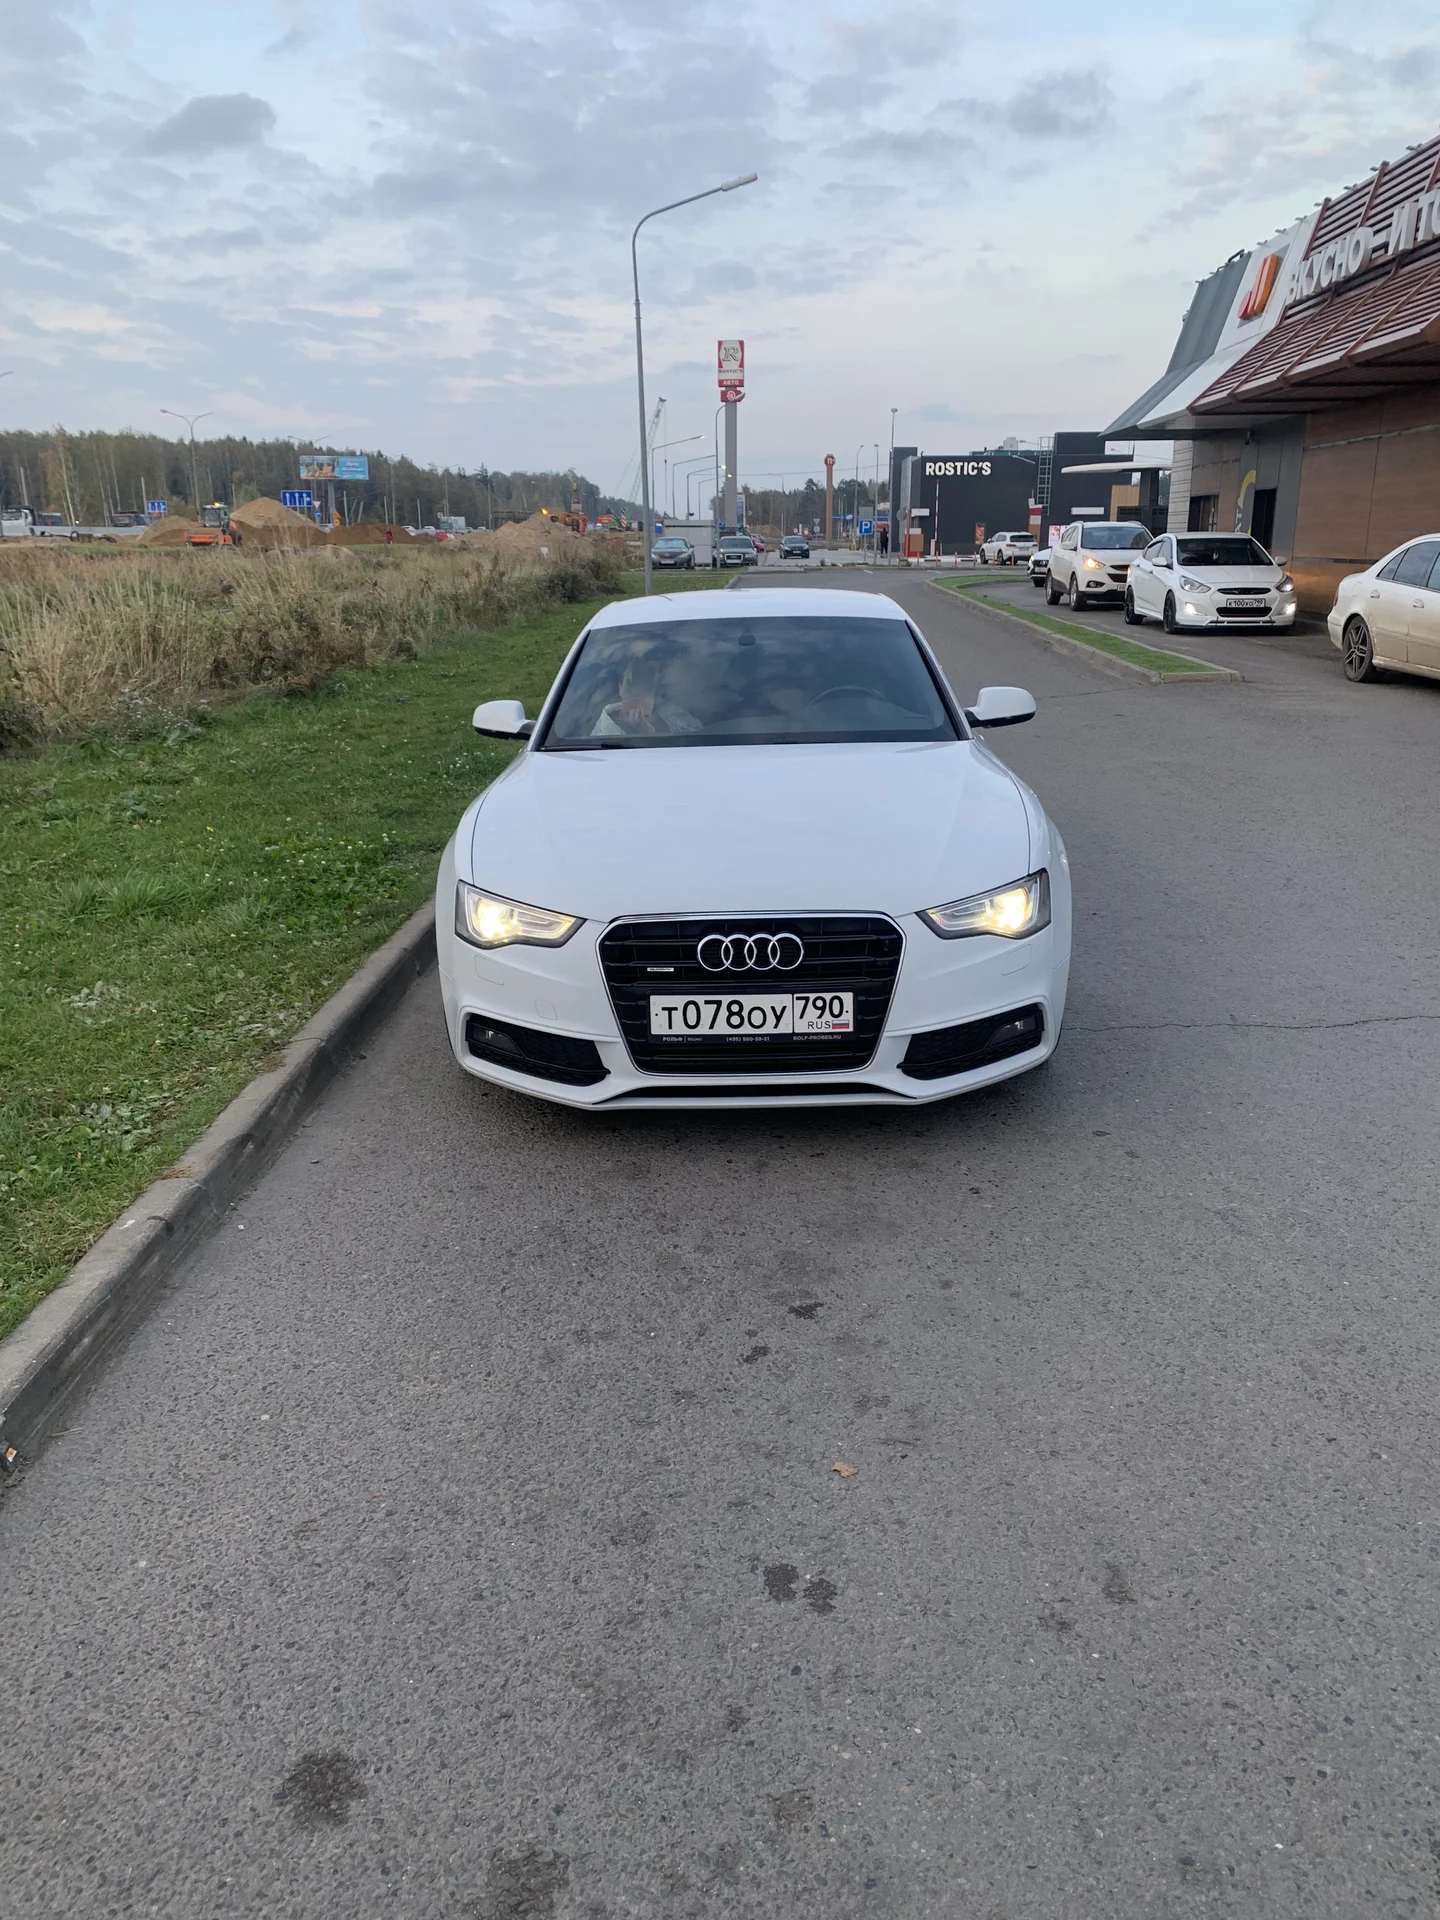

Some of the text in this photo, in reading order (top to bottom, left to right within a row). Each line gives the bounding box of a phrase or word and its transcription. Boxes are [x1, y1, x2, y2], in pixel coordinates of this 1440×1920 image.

[925, 461, 992, 476] ROSTIC'S
[862, 521, 871, 533] P
[795, 995, 845, 1020] 790
[807, 1020, 831, 1030] RUS
